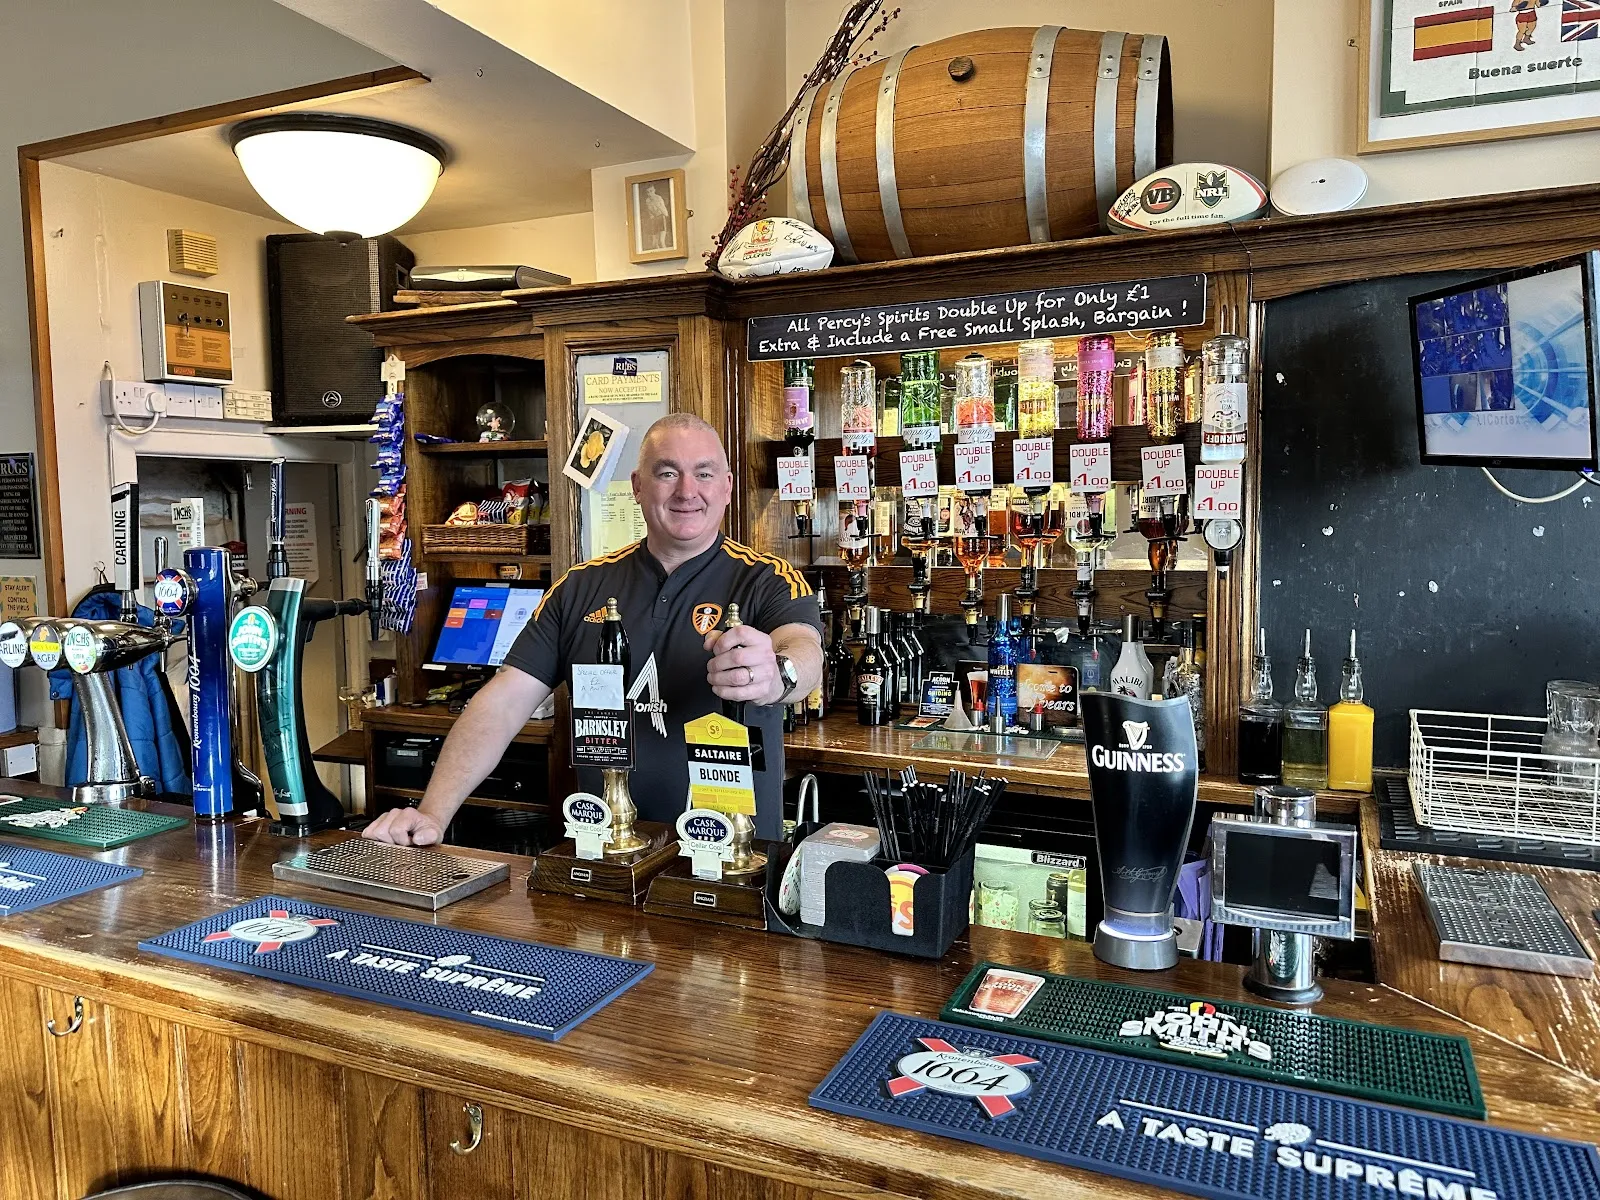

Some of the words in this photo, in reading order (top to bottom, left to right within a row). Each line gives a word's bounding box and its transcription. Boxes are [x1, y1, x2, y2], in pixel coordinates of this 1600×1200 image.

[1468, 64, 1522, 80] Buena
[1527, 55, 1583, 73] suerte
[1149, 187, 1175, 204] VB
[1195, 186, 1227, 198] NRL
[787, 318, 810, 333] All
[818, 313, 871, 335] Percy's
[878, 307, 930, 332] Spirits
[938, 299, 998, 319] Double
[1005, 298, 1028, 320] Up
[1035, 292, 1066, 314] for
[1074, 288, 1118, 311] Only
[1127, 284, 1150, 302] £1
[759, 338, 801, 353] Extra
[807, 334, 821, 352] &
[827, 330, 894, 348] Include
[900, 332, 911, 342] a
[918, 325, 957, 340] Free
[965, 317, 1015, 338] Small
[1023, 315, 1086, 338] Splash,
[1093, 305, 1173, 327] Bargain
[585, 376, 610, 386] CARD
[611, 374, 660, 385] PAYMENTS
[599, 386, 615, 394] NOW
[615, 385, 647, 393] ACCEPTED
[1205, 432, 1247, 444] SMIRNOFF
[956, 445, 991, 456] DOUBLE
[1015, 441, 1051, 452] DOUBLE
[1071, 447, 1109, 458] DOUBLE
[901, 453, 934, 464] DOUBLE
[967, 456, 980, 465] UP
[1026, 452, 1040, 461] UP
[1143, 448, 1183, 461] DOUBLE
[0, 461, 28, 475] RUGS
[778, 459, 809, 469] DOUBLE
[835, 459, 866, 469] DOUBLE
[912, 463, 924, 472] UP
[1083, 458, 1097, 467] UP
[1156, 460, 1171, 469] UP
[788, 469, 800, 477] UP
[846, 469, 857, 477] UP
[958, 470, 991, 484] £1.00
[1016, 467, 1051, 480] £1.00
[1197, 469, 1239, 479] DOUBLE
[904, 477, 936, 491] £1.00
[1073, 473, 1109, 487] £1.00
[1145, 475, 1184, 490] £1.00
[1210, 480, 1225, 490] UP
[1197, 496, 1238, 511] £1.00
[114, 510, 127, 565] CARLING
[158, 586, 178, 598] 1664
[0, 643, 25, 655] ARLING
[989, 668, 1014, 676] WHITLEY
[1112, 675, 1145, 689] MALIBU
[1058, 683, 1073, 694] to
[192, 692, 202, 749] Kronenbourg
[574, 718, 629, 740] BARNSLEY
[585, 737, 618, 745] BITTER
[694, 748, 742, 761] SALTAIRE
[1091, 744, 1185, 773] GUINNESS
[699, 767, 741, 784] BLONDE
[576, 801, 596, 812] CASK
[571, 808, 604, 820] MARQUE
[574, 824, 589, 832] Cellar
[589, 825, 602, 833] Cool
[693, 818, 717, 828] CASK
[687, 825, 725, 837] MARQUE
[690, 841, 708, 850] Cellar
[708, 843, 723, 851] Cool
[1036, 853, 1080, 868] Blizzard
[325, 949, 349, 960] A
[350, 952, 420, 974] TASTE
[1144, 1010, 1248, 1038] JOHN
[1119, 1020, 1272, 1062] SMITH'S
[936, 1052, 1005, 1070] Kronenbourg
[912, 1059, 1010, 1091] 1664
[1096, 1109, 1125, 1130] A
[1141, 1116, 1256, 1159] TASTE
